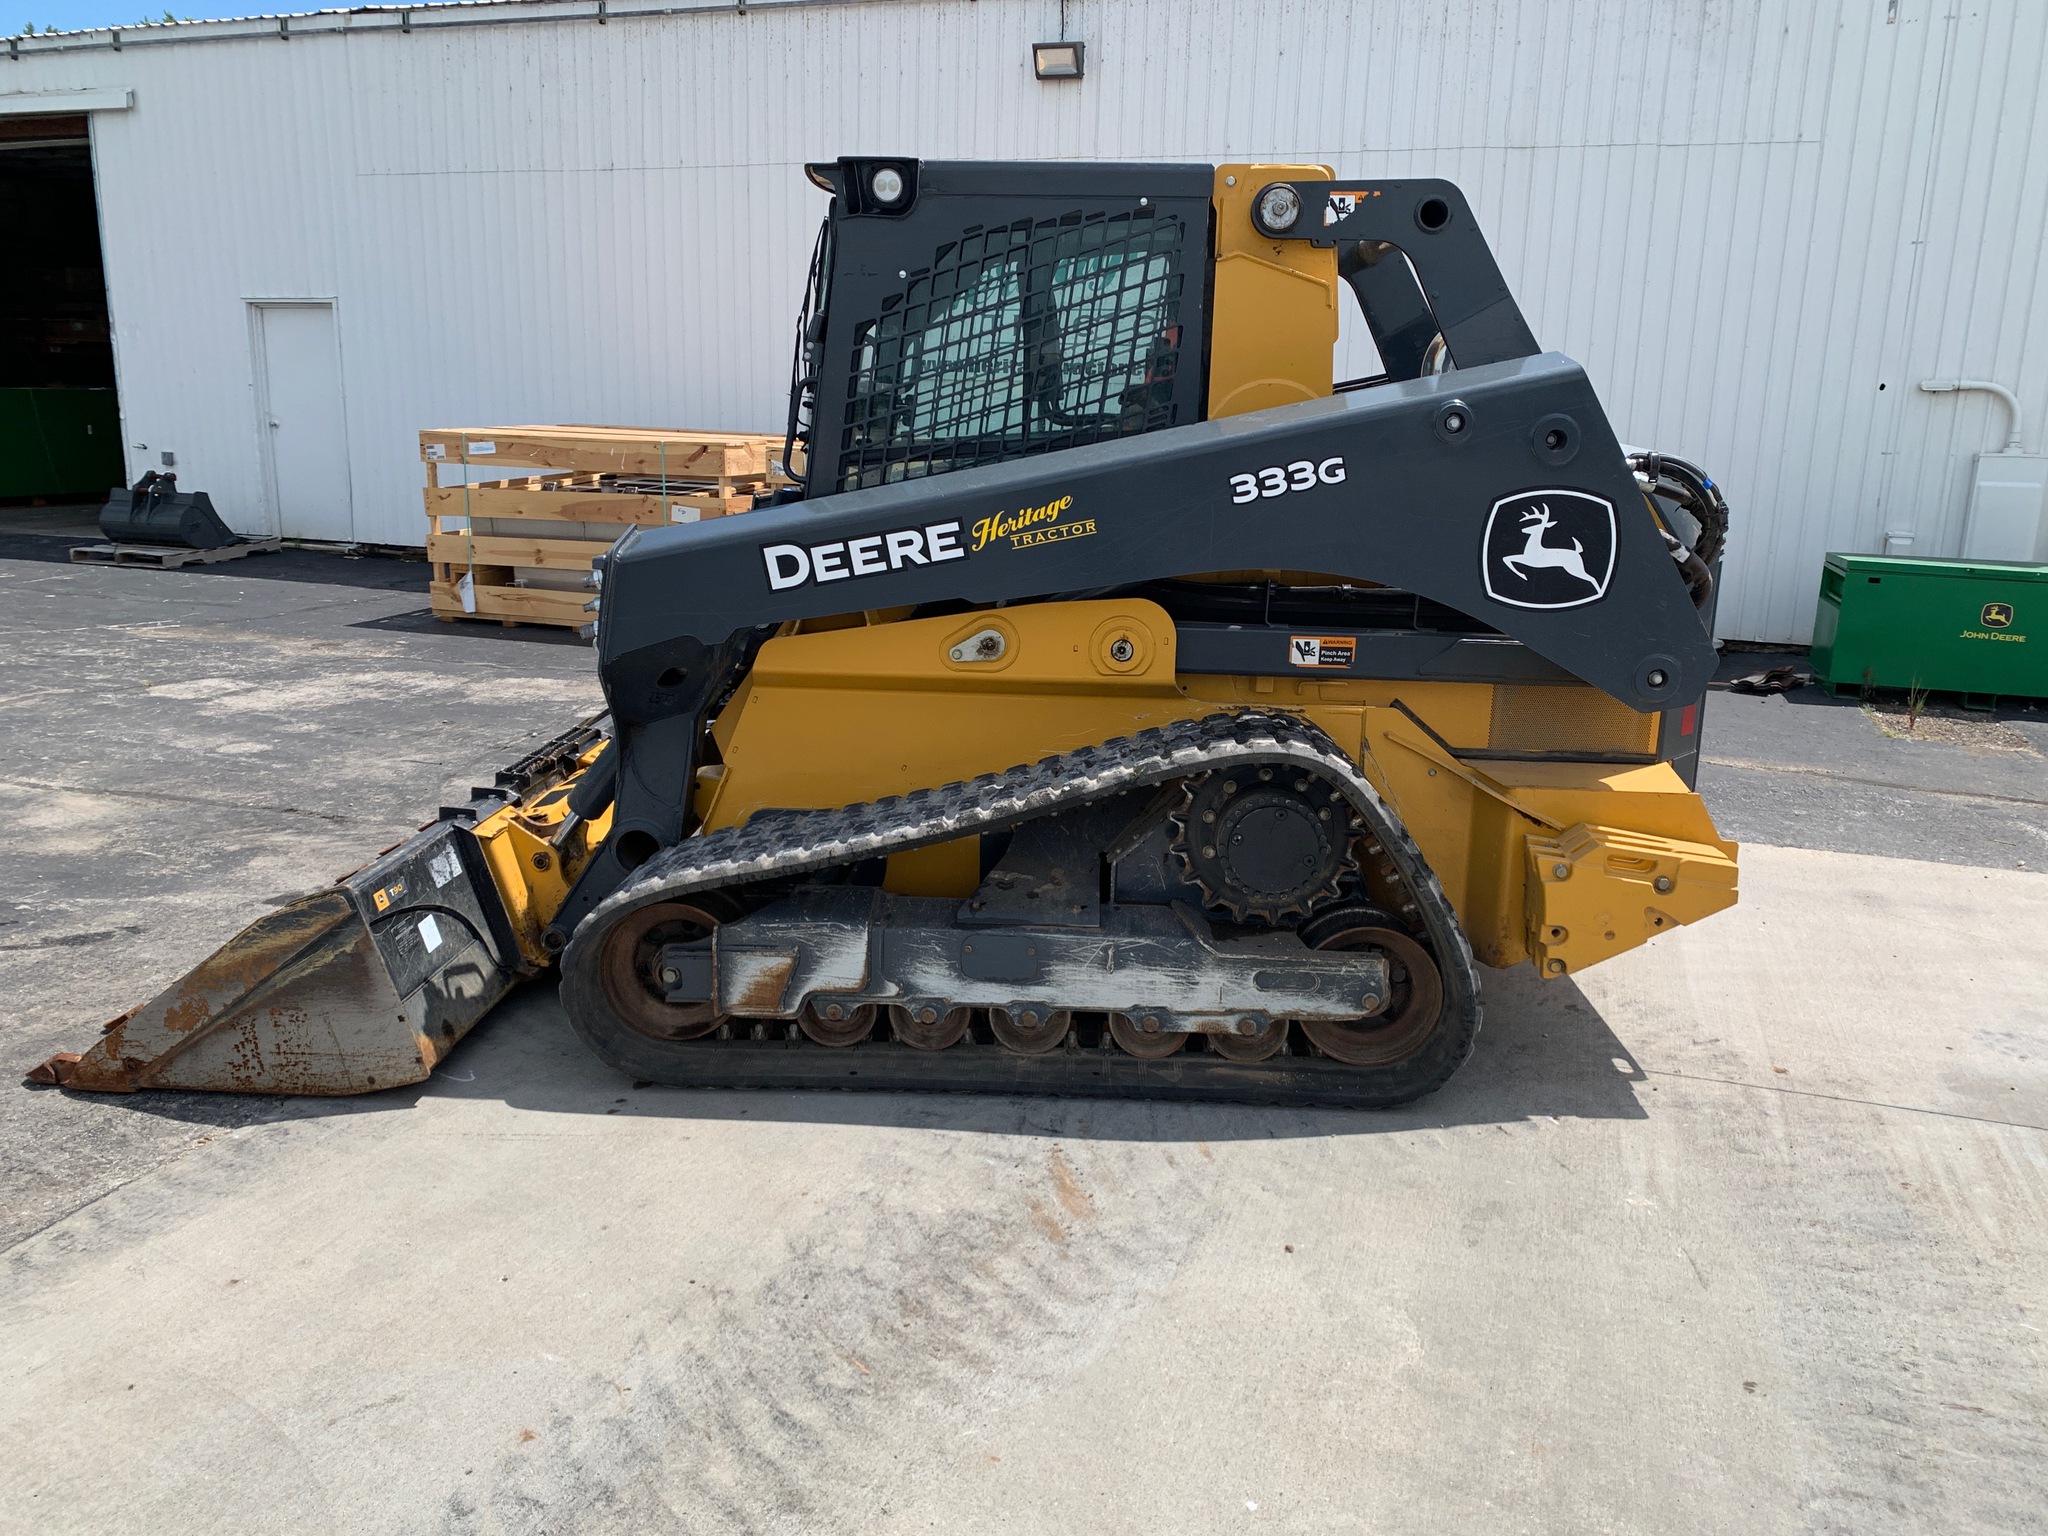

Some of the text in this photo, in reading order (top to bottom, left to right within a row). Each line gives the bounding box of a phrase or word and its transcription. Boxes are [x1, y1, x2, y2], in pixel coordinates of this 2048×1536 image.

[1229, 457, 1346, 504] 333G
[971, 494, 1074, 552] Heritage
[1010, 521, 1097, 547] TRACTOR
[763, 521, 966, 590] DEERE
[1960, 630, 2026, 642] JOHN DEERE
